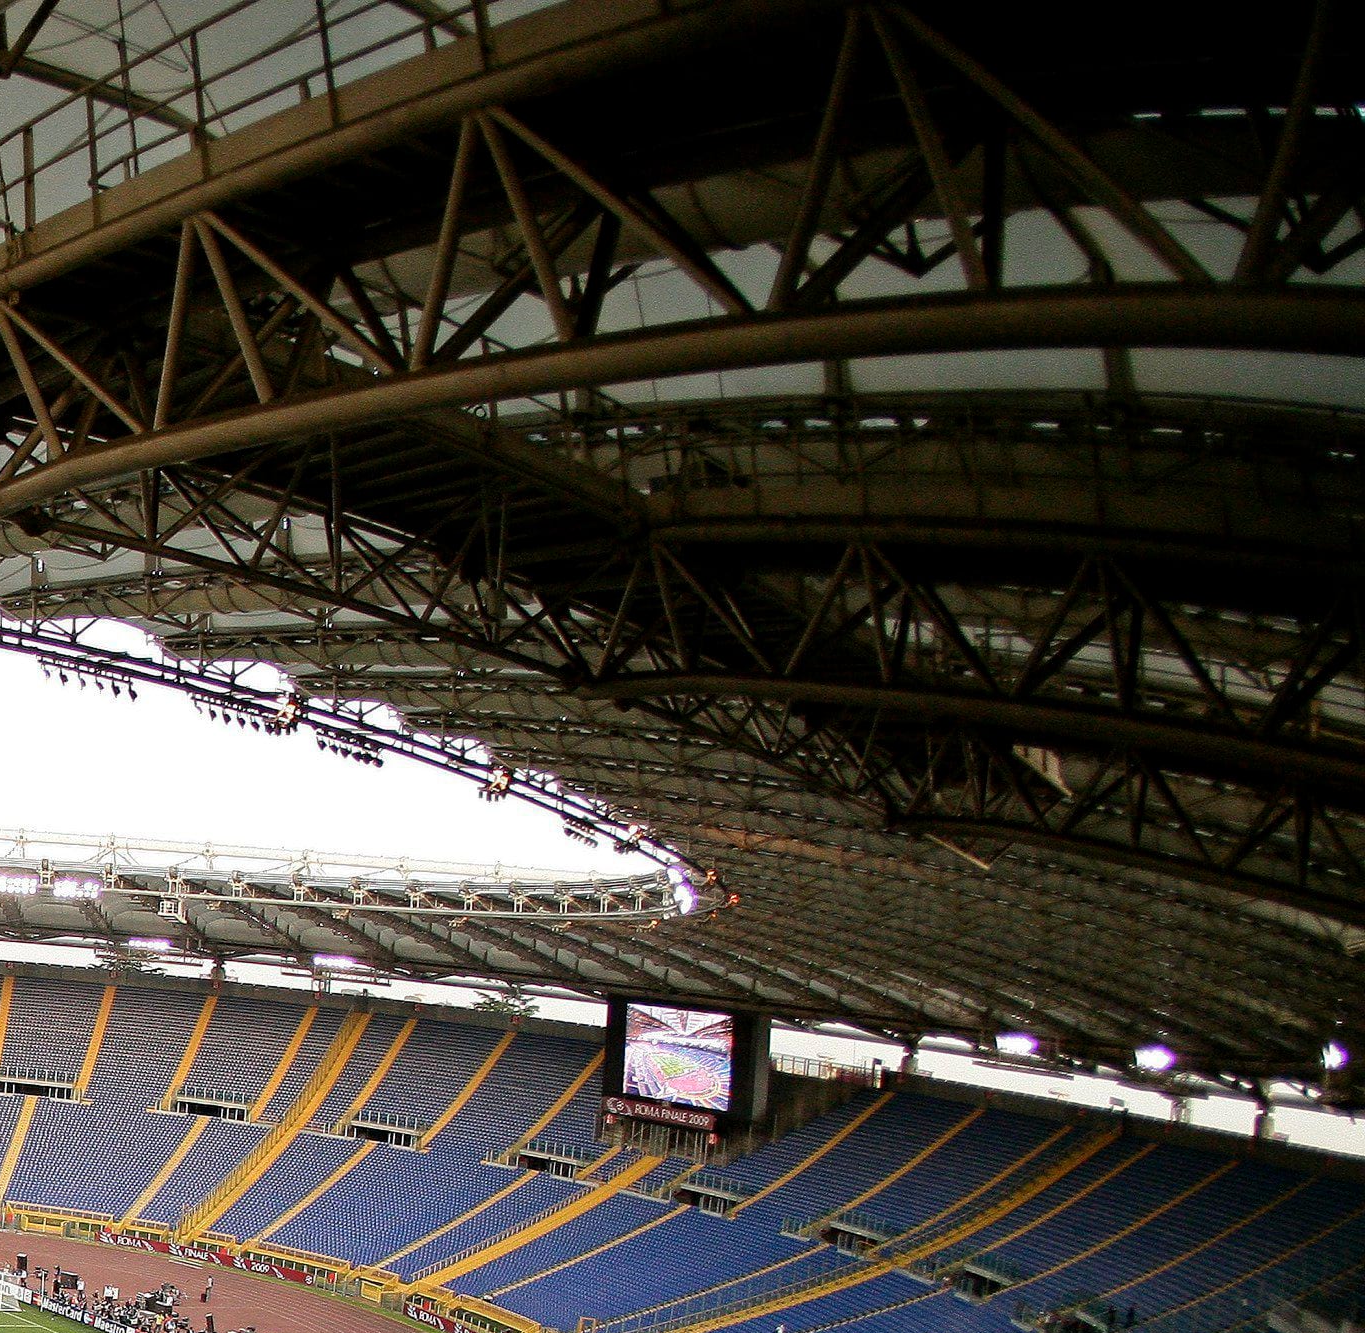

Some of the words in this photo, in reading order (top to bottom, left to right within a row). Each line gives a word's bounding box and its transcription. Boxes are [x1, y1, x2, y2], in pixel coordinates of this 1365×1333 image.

[635, 1104, 660, 1118] ROMA
[661, 1108, 687, 1122] FINALE
[689, 1114, 709, 1126] 2009
[117, 1236, 142, 1248] ROMA
[184, 1248, 208, 1261] FINALE
[250, 1260, 270, 1273] 2009
[43, 1298, 82, 1322] MasterCard
